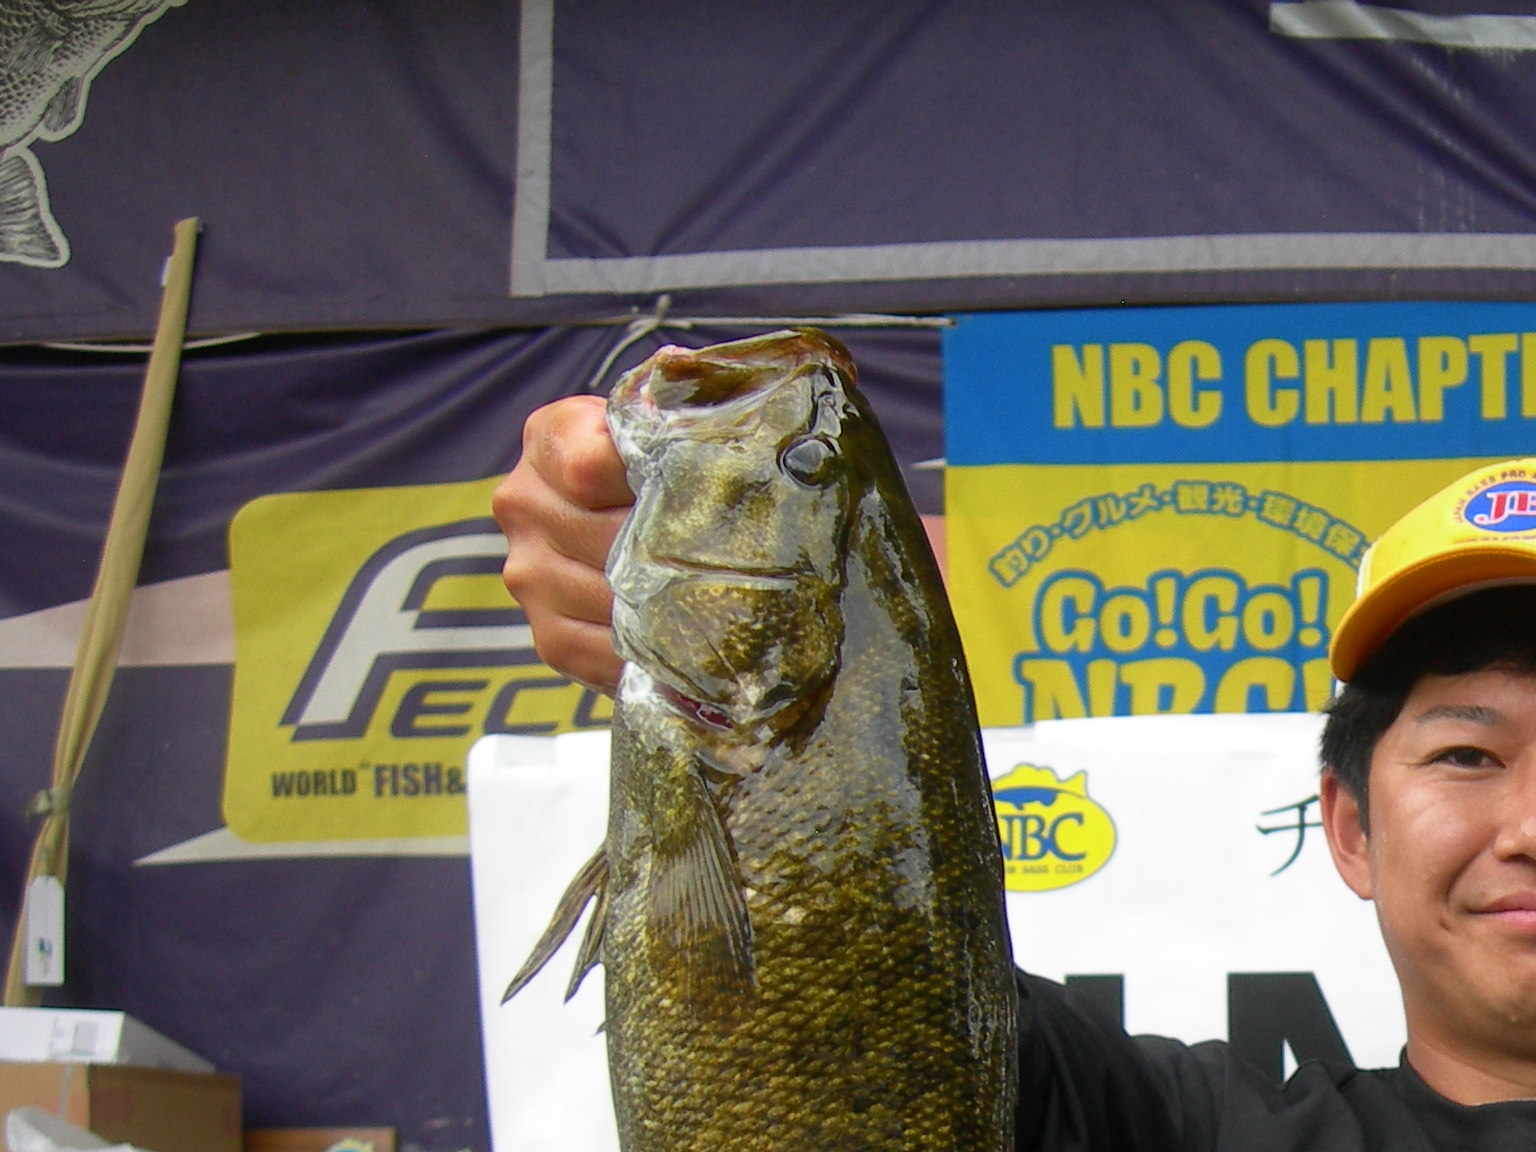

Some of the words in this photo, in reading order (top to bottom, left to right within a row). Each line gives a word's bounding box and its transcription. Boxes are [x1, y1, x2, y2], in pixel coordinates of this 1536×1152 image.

[1051, 341, 1223, 430] NBC
[1500, 469, 1527, 481] PRO
[271, 767, 358, 797] WORLD
[1054, 864, 1084, 874] CLUB
